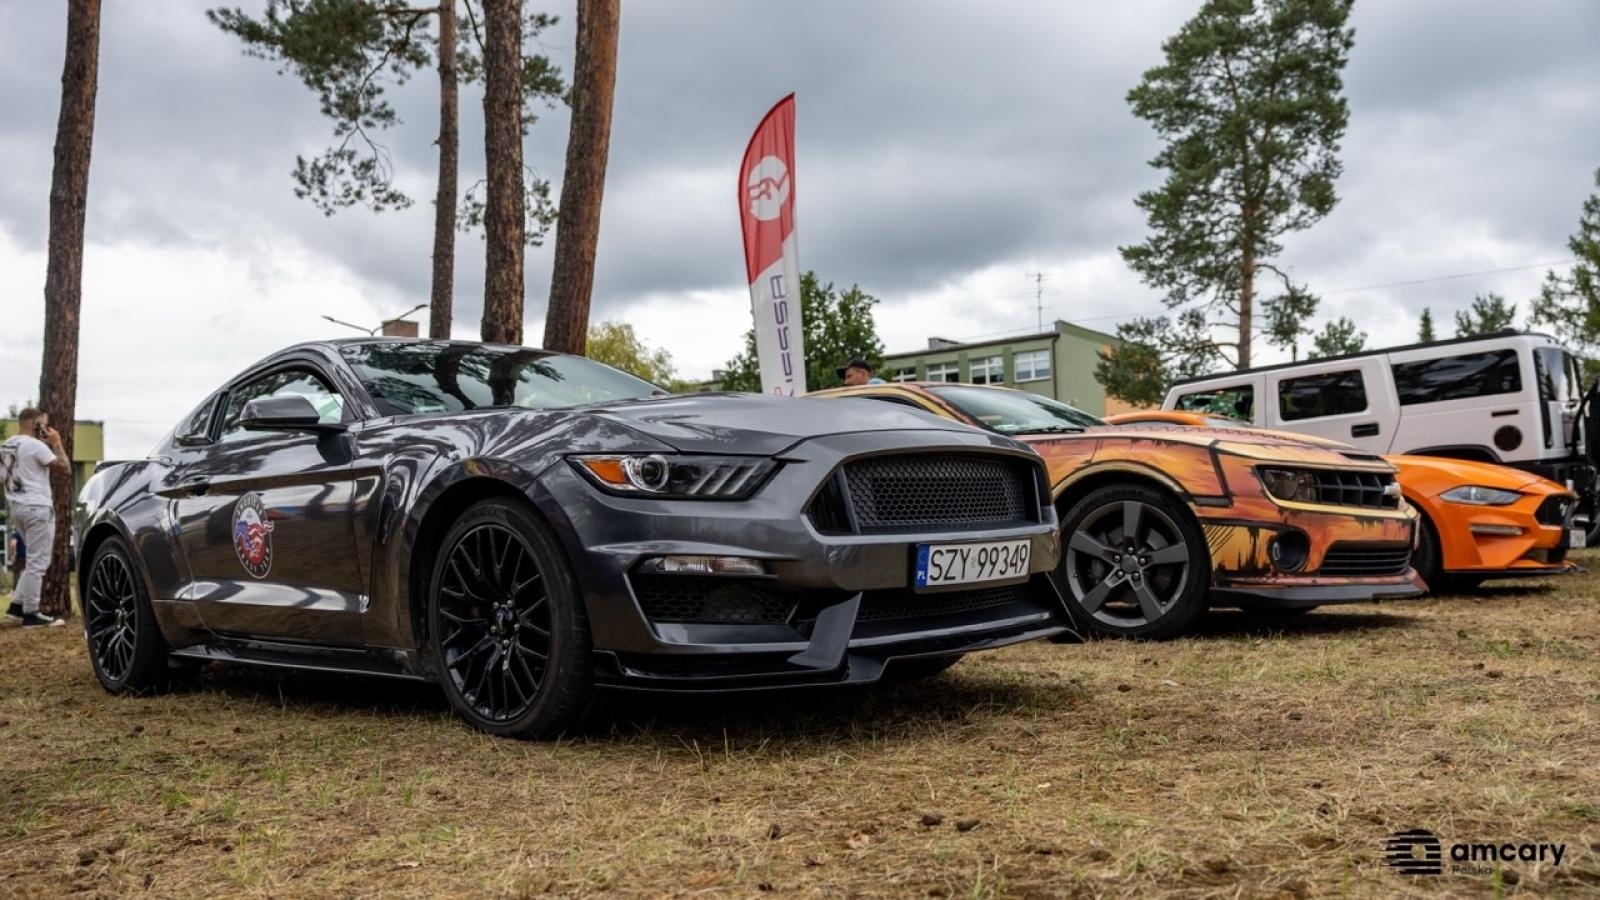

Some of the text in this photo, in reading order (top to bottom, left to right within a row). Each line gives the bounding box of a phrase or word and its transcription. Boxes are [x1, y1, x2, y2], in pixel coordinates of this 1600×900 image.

[929, 543, 1028, 581] SZY 99349
[917, 570, 926, 580] PL
